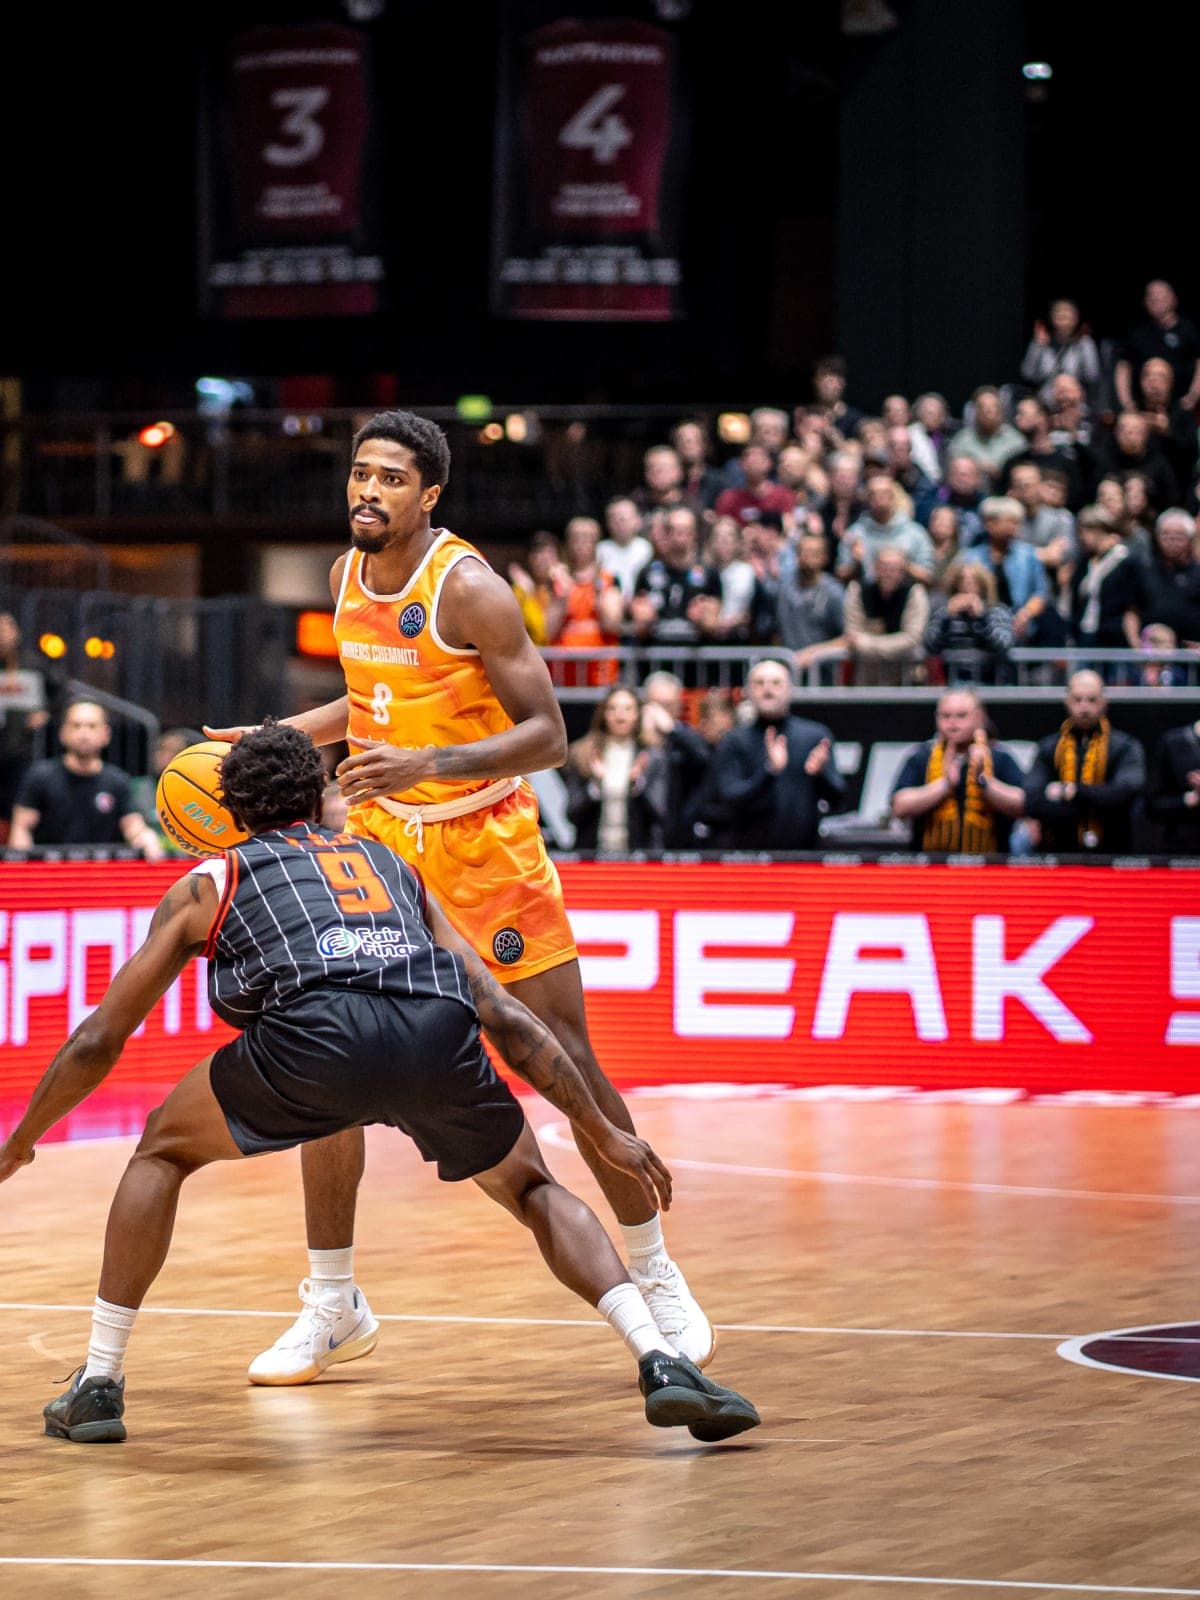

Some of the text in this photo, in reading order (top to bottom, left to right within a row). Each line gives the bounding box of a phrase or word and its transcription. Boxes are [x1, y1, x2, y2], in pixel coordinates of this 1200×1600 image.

[262, 85, 331, 166] 3
[559, 83, 632, 163] 4
[371, 682, 393, 725] 8
[316, 851, 394, 914] 9
[355, 927, 401, 943] Fair
